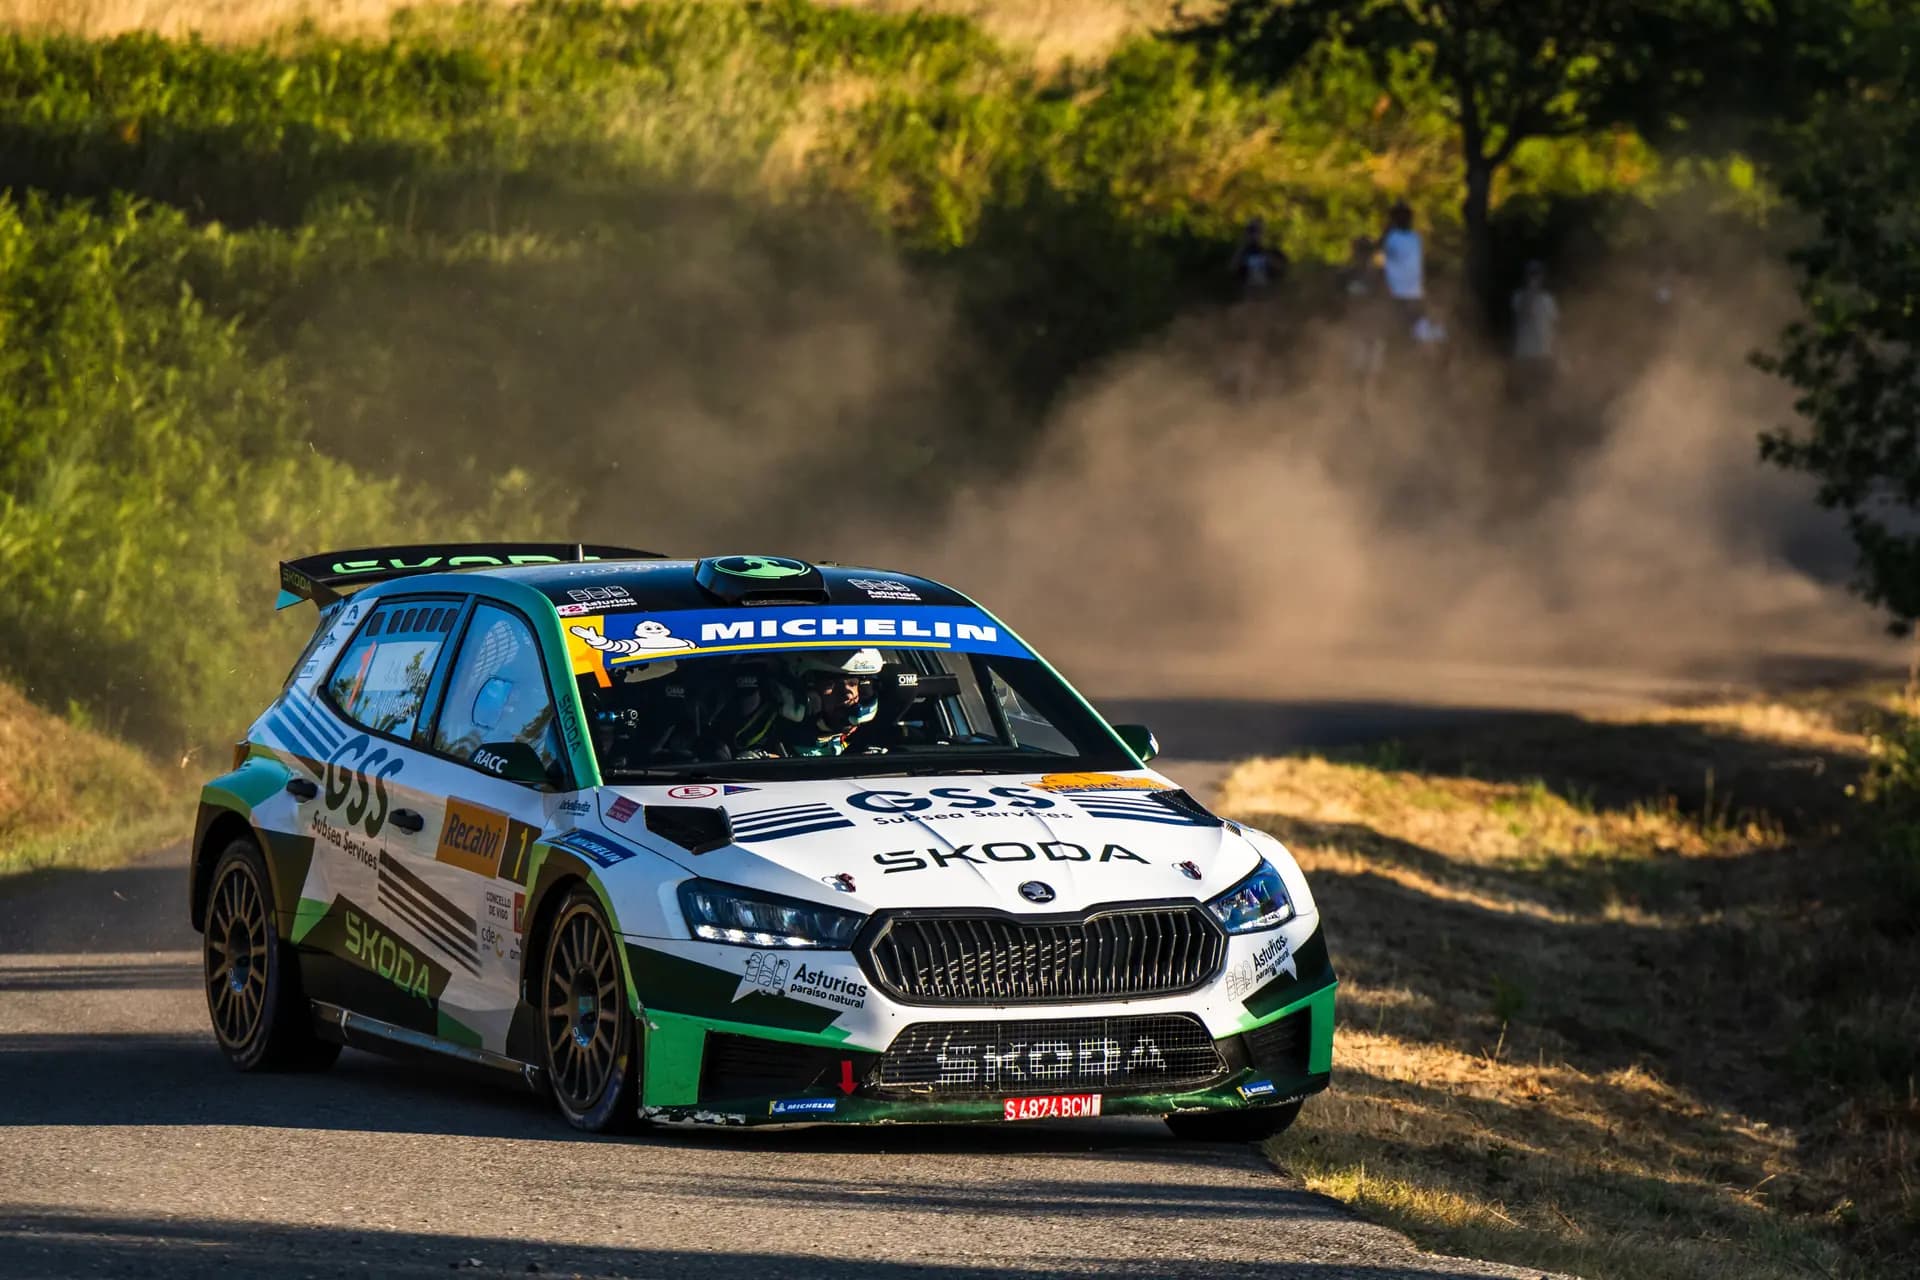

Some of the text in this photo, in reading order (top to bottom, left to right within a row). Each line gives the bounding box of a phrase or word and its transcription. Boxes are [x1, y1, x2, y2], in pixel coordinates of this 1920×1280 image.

[282, 567, 313, 592] SKODA
[581, 598, 635, 607] Asturias
[701, 618, 997, 642] MICHELIN
[558, 694, 582, 756] SKODA
[473, 749, 508, 774] RACC
[325, 734, 404, 839] GSS
[846, 786, 1056, 814] GSS
[873, 808, 1074, 825] Subsea Services
[311, 809, 378, 870] Subsea Services
[444, 812, 502, 860] Recalvi
[513, 827, 529, 880] 1
[872, 839, 1152, 875] SKODA
[486, 891, 512, 909] CONCELLO
[488, 904, 509, 921] DE VIGO
[344, 910, 433, 1009] SKODA
[1252, 934, 1288, 972] Asturias
[789, 983, 865, 1009] paraíso natural
[793, 962, 868, 998] Asturias
[936, 1035, 1168, 1084] SKODA
[1004, 1096, 1091, 1121] S 4874 BCM
